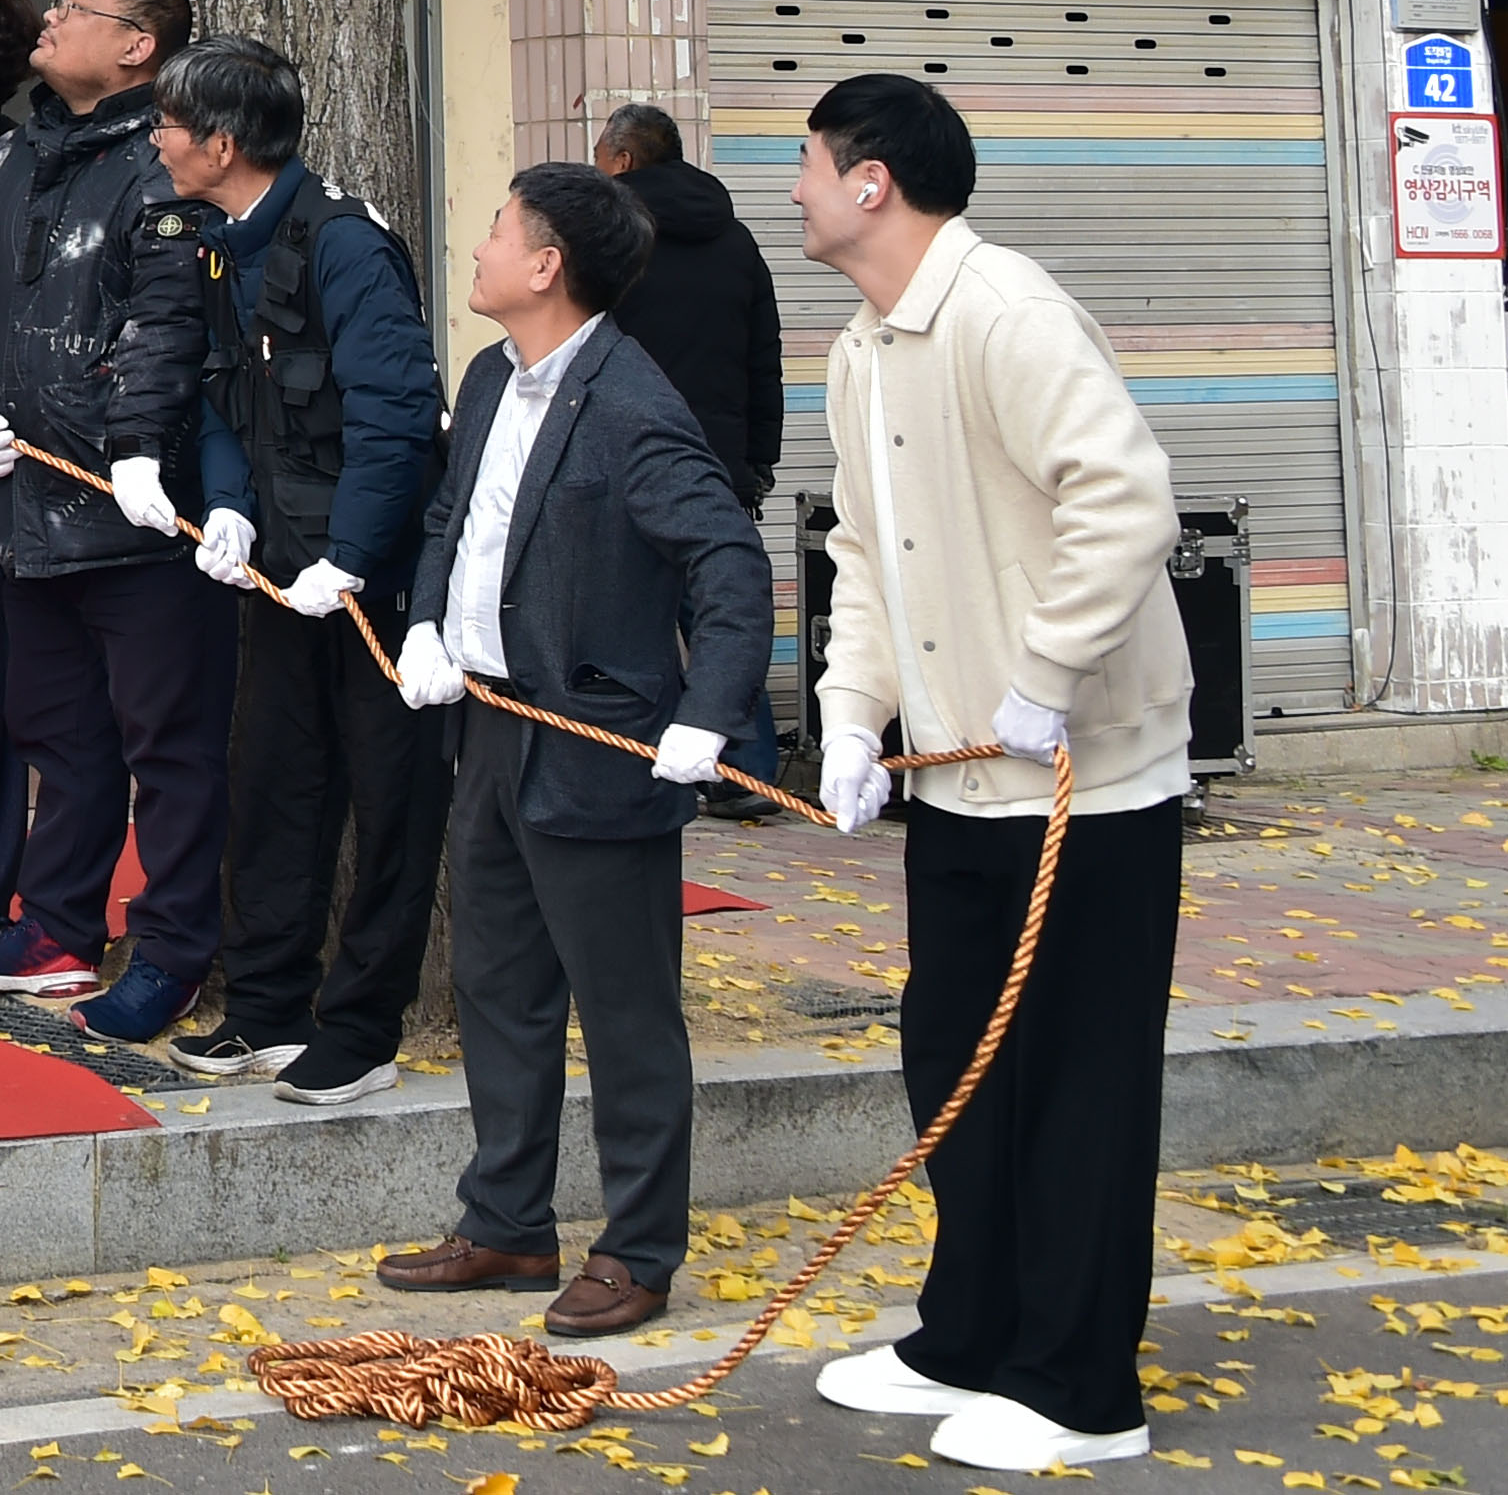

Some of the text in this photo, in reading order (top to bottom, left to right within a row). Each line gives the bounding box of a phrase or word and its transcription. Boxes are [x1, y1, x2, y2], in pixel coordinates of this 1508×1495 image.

[1424, 73, 1457, 102] 42
[1404, 179, 1491, 202] 영상감시구역
[1406, 226, 1429, 239] HCN
